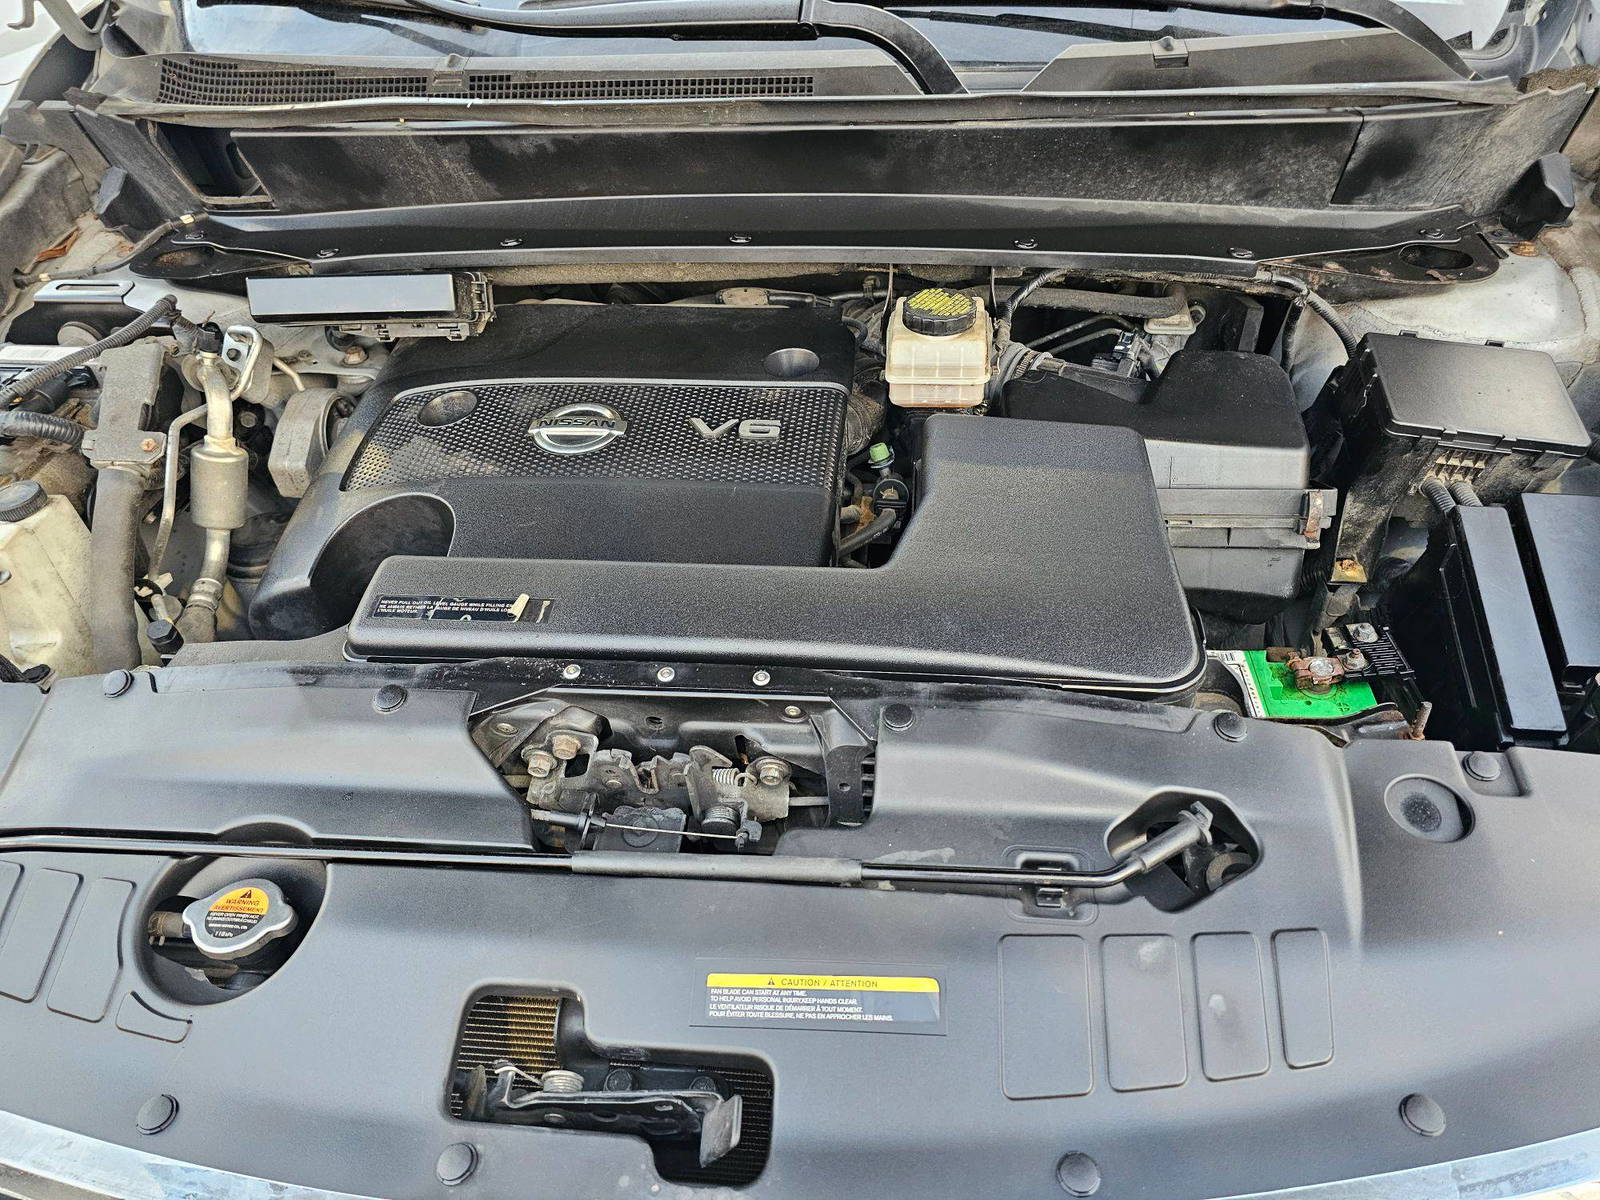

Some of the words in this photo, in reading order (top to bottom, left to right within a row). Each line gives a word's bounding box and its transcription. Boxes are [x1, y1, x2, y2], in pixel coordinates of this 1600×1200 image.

[537, 418, 616, 429] NISSAN
[688, 417, 781, 441] V6
[781, 978, 820, 986] CAUTION
[830, 980, 878, 988] ATTENTION
